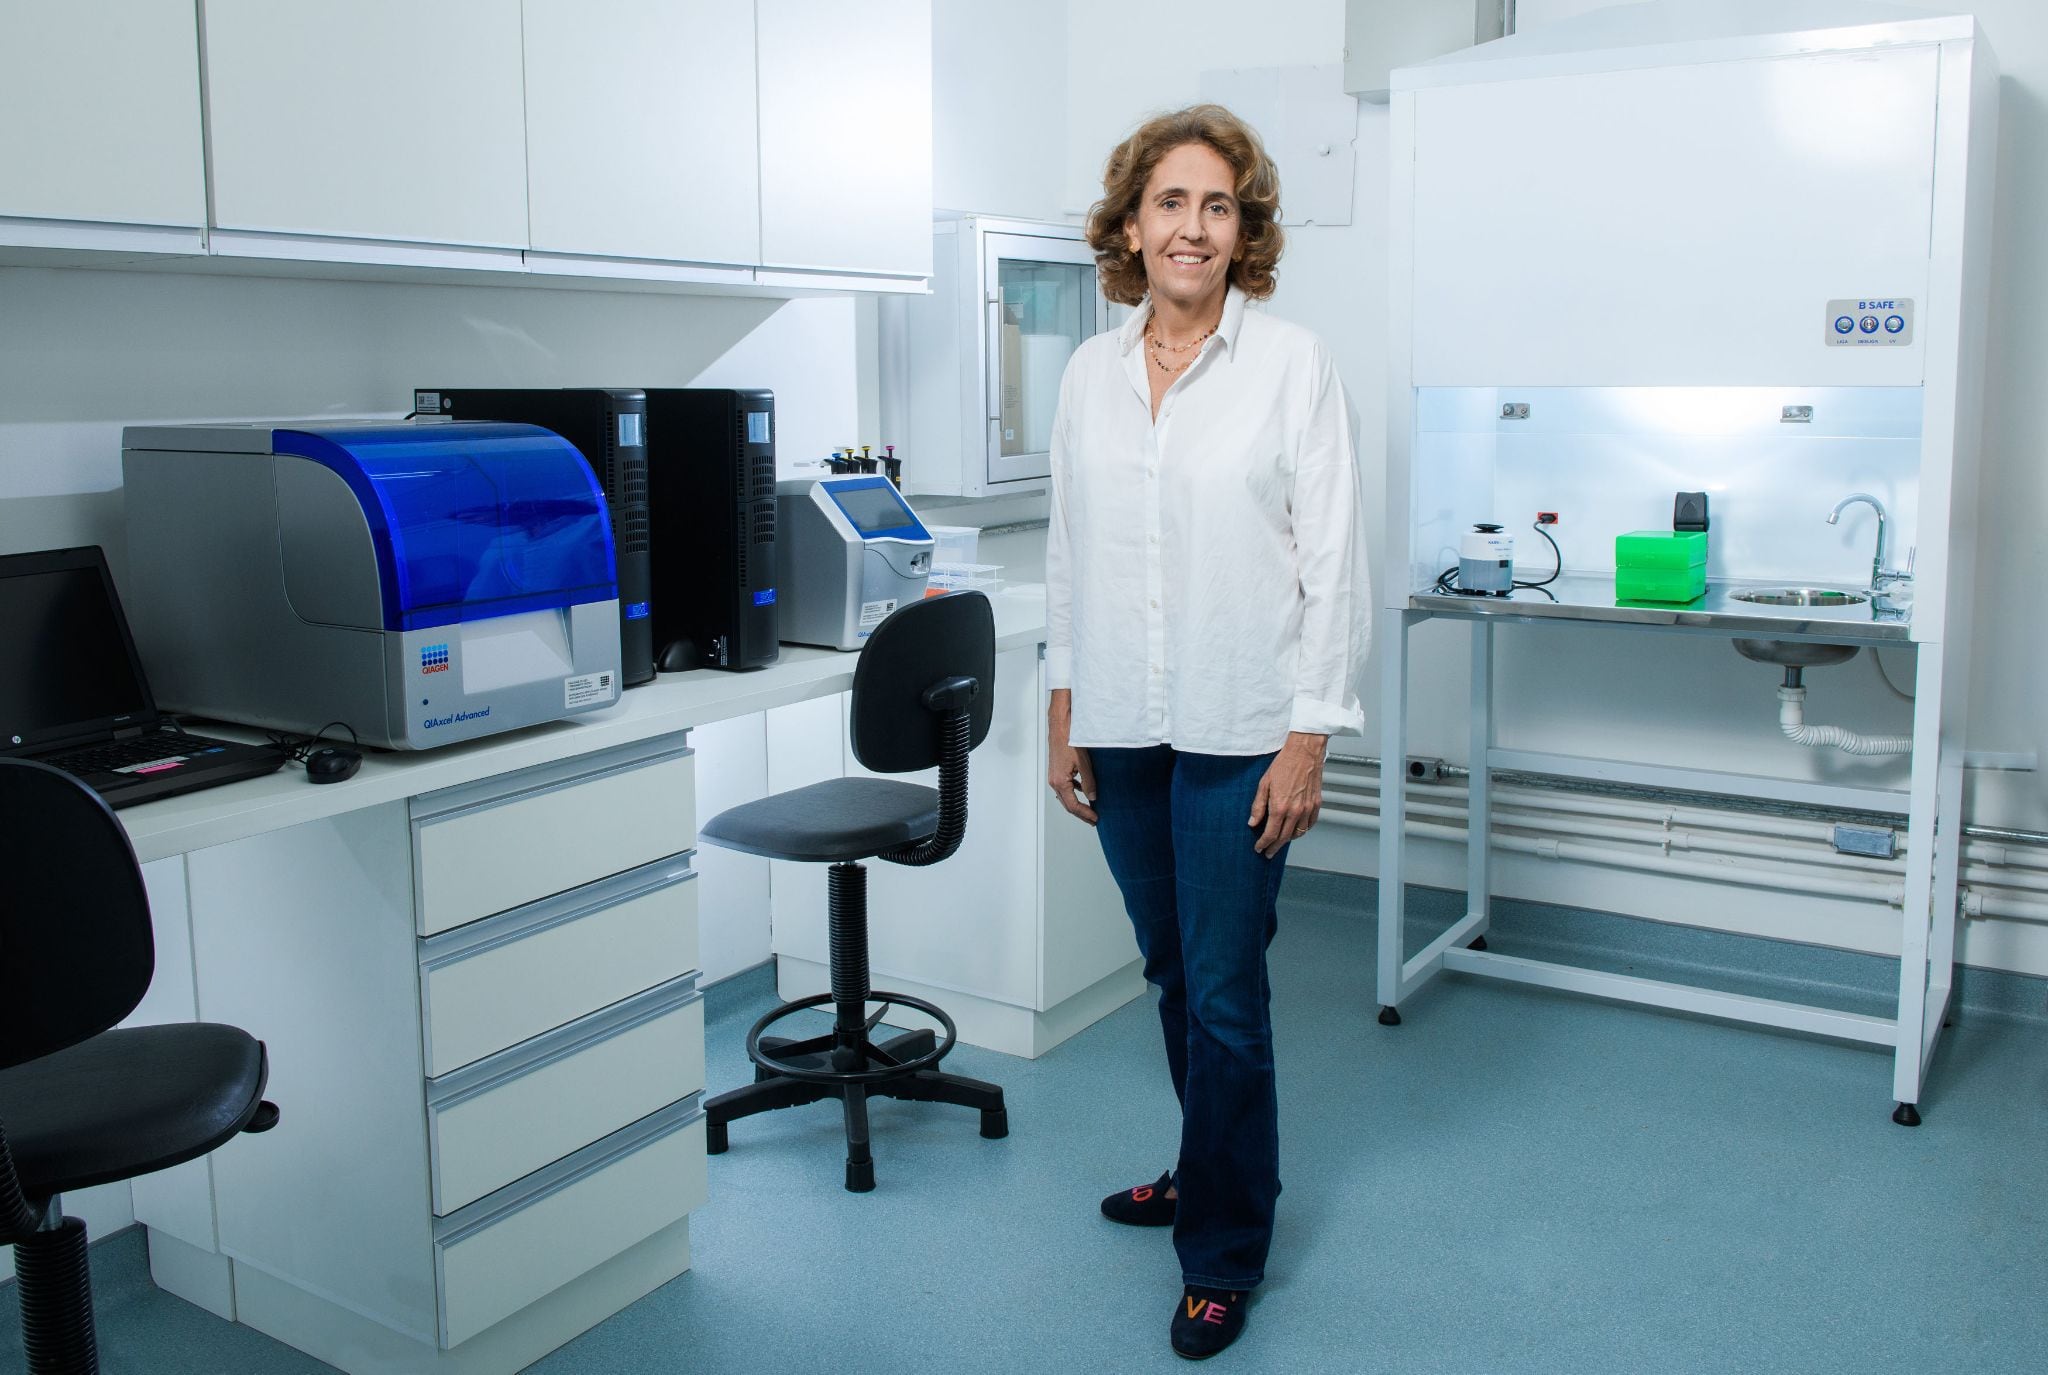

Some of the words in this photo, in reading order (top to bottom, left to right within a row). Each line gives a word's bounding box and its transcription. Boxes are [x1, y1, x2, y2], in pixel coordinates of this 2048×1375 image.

[1859, 302, 1866, 310] B
[1868, 301, 1894, 309] SAFE
[422, 664, 449, 674] QIAGEN
[424, 714, 454, 729] QIAxcel
[455, 706, 490, 722] Advanced
[1186, 1296, 1227, 1325] VE
